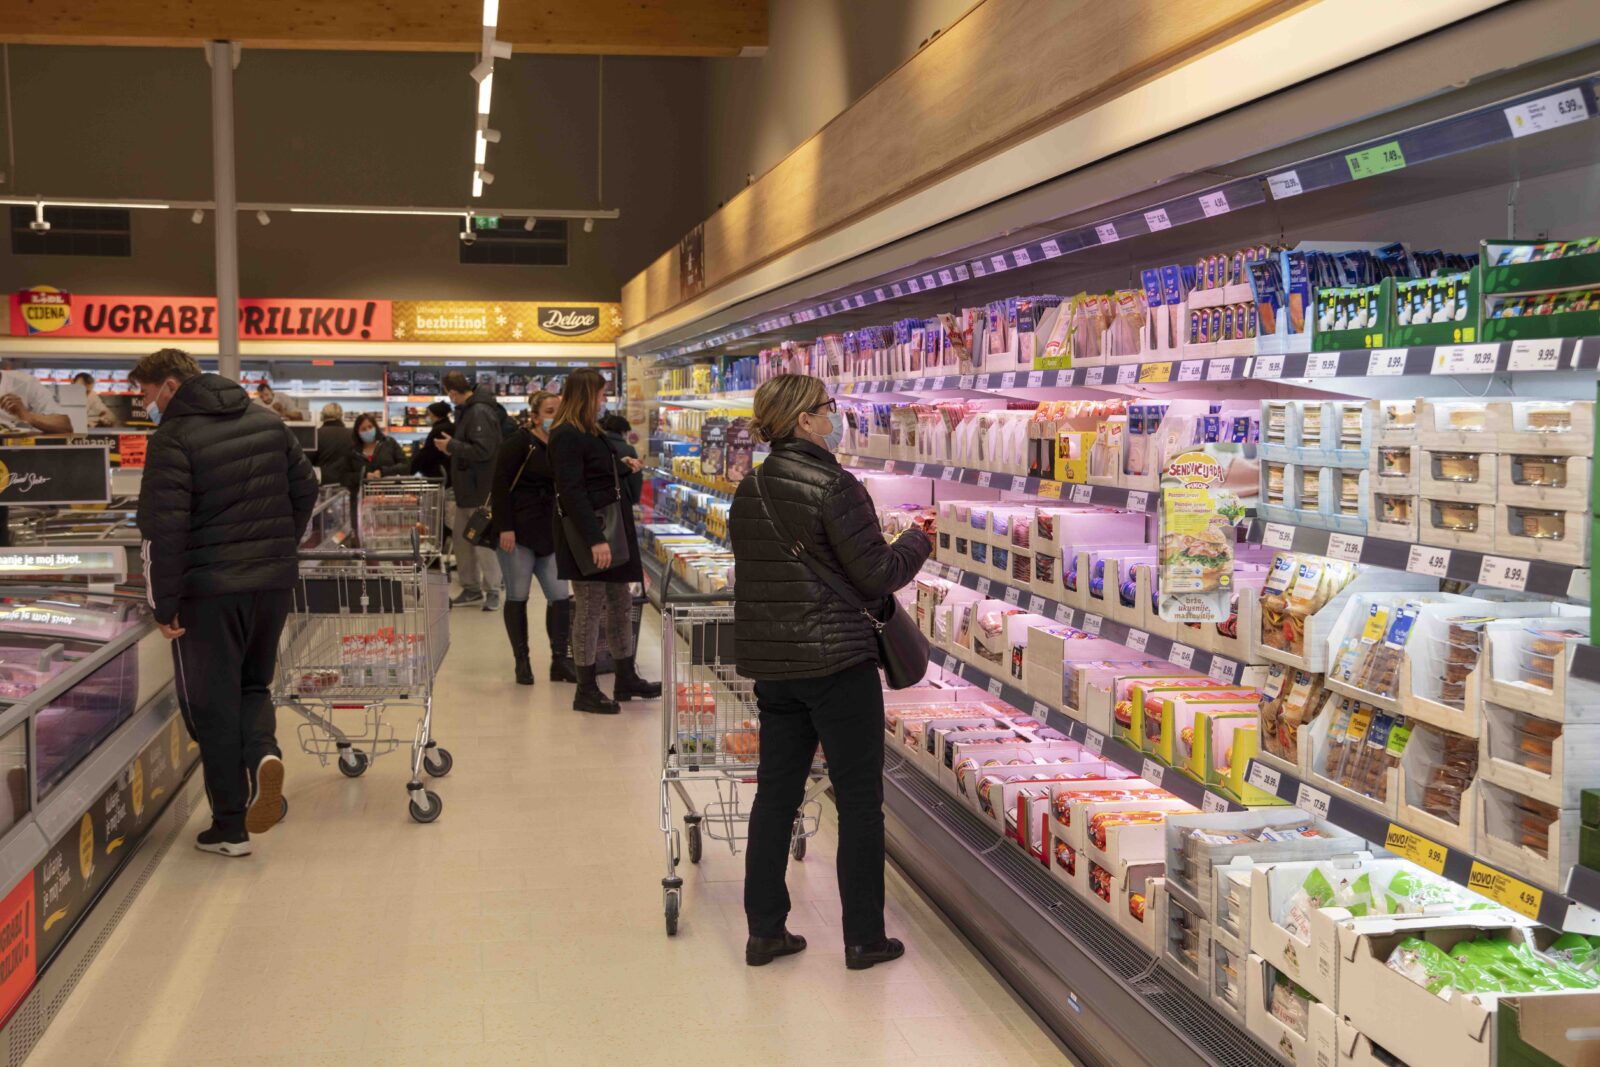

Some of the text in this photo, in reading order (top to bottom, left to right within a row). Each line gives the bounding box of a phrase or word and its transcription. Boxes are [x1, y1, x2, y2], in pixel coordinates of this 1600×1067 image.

[1558, 98, 1577, 114] 6.99
[26, 306, 66, 321] CIJENA
[83, 303, 216, 335] UGRABI
[542, 310, 595, 329] Deluxe
[416, 315, 487, 329] bezbrižno!
[1473, 353, 1492, 364] 10.99
[1537, 348, 1556, 360] 9.99
[24, 554, 34, 565] je
[36, 555, 55, 566] moj
[56, 554, 82, 565] život.
[1429, 555, 1444, 568] 4.99
[1504, 567, 1522, 581] 8.99
[1313, 798, 1326, 812] 17.99
[1428, 848, 1441, 862] 9.99
[1470, 871, 1497, 890] NOVO!
[1519, 891, 1535, 906] 4.99
